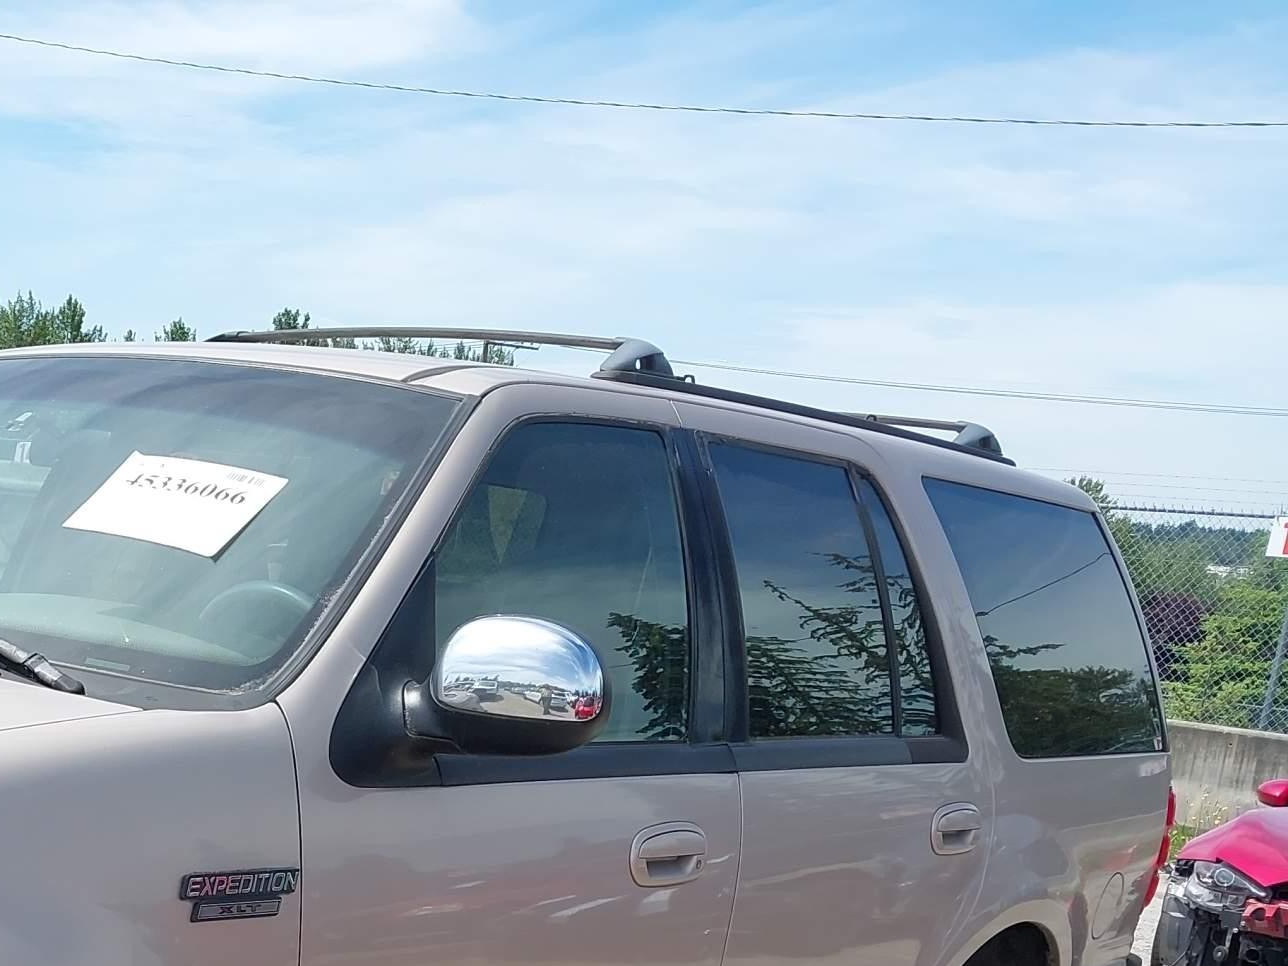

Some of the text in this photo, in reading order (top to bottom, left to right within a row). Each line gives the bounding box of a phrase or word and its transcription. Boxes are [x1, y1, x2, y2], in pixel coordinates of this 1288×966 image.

[125, 472, 247, 505] 45336066
[185, 871, 300, 898] EXPEDITION
[217, 903, 262, 915] XLT
